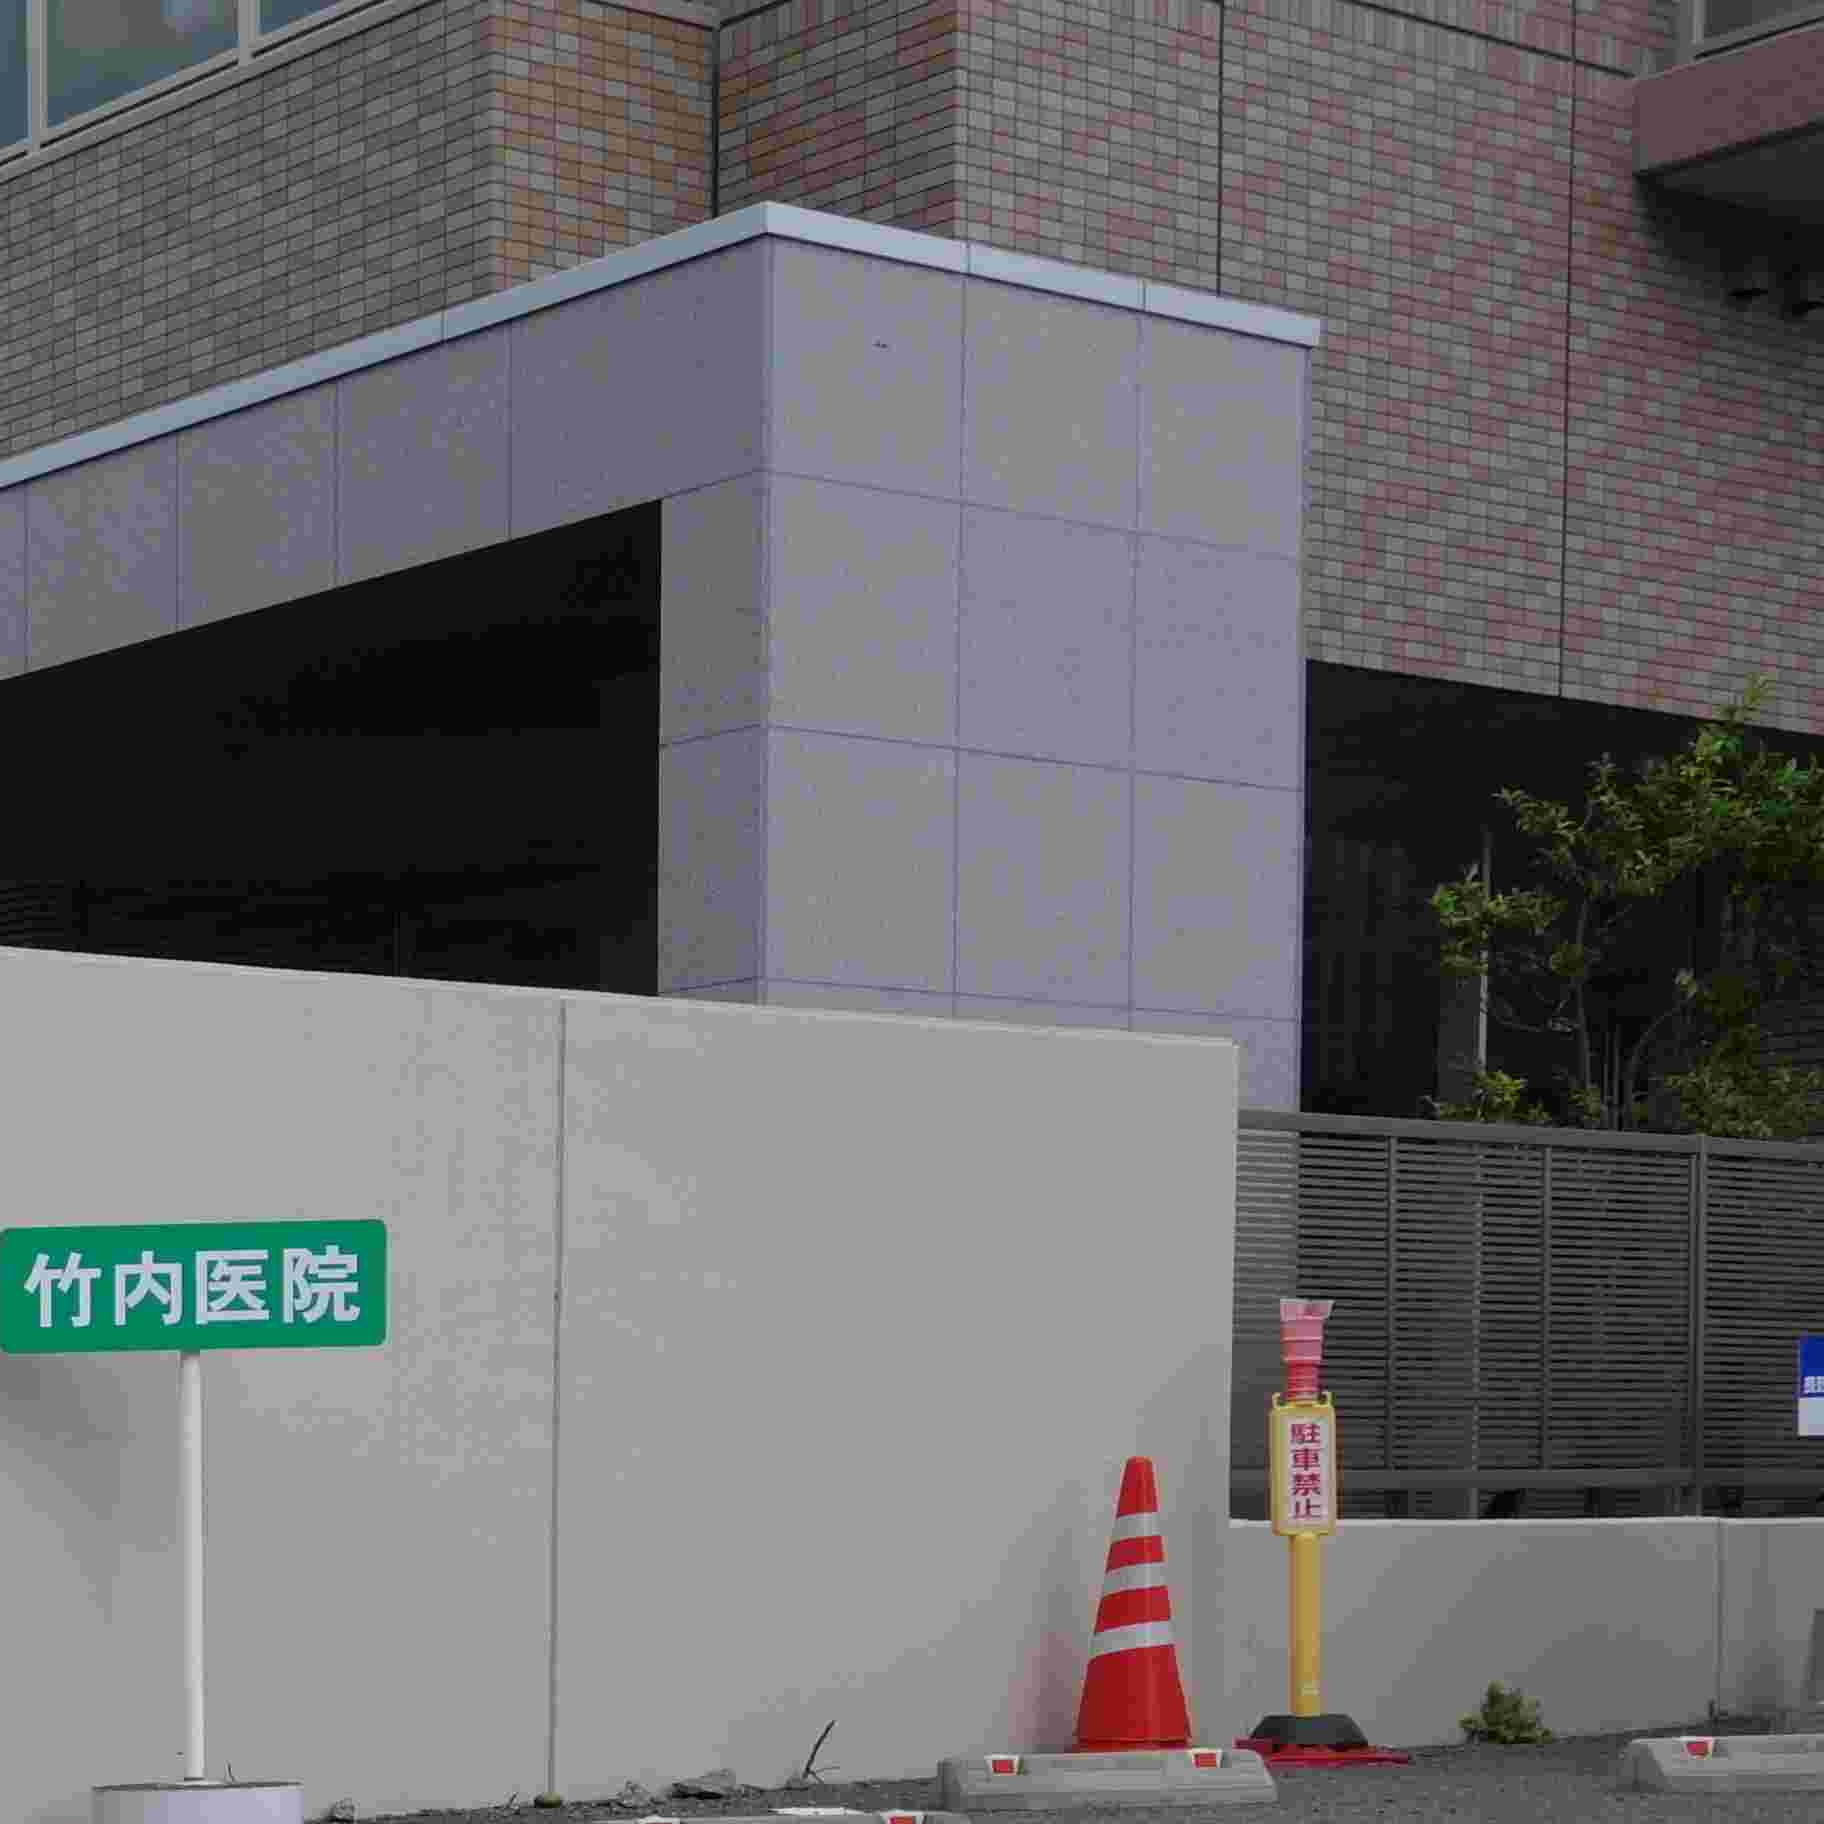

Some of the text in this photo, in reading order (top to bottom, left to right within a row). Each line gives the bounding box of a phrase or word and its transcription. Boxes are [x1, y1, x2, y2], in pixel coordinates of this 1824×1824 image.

[23, 1244, 361, 1328] 竹内医院
[1290, 1422, 1322, 1520] 駐車禁止
